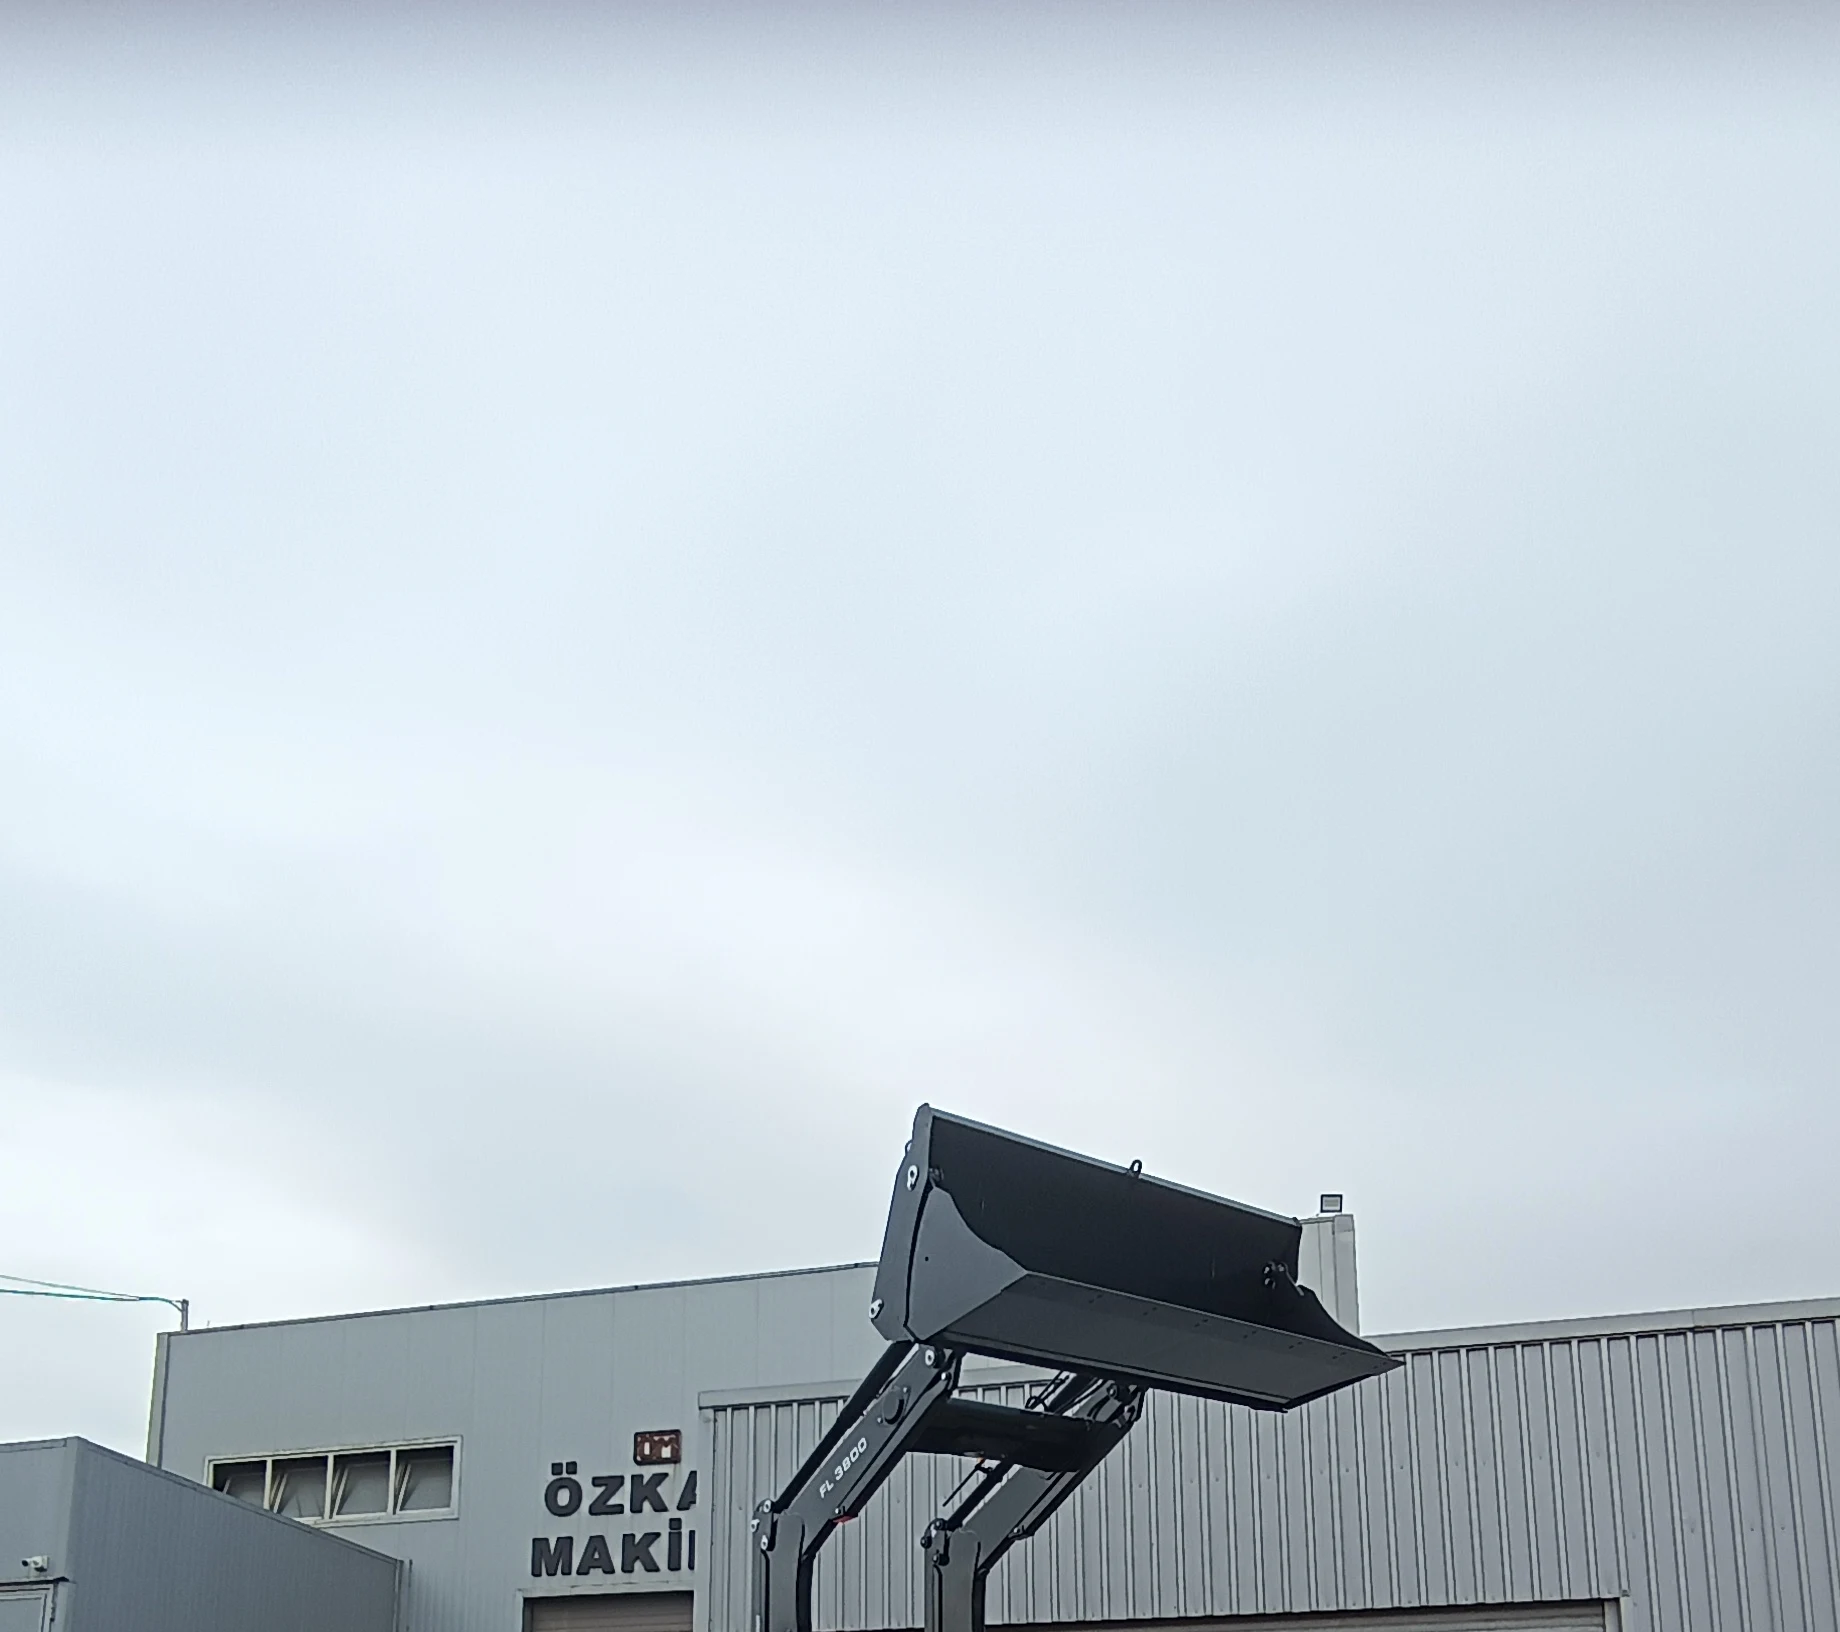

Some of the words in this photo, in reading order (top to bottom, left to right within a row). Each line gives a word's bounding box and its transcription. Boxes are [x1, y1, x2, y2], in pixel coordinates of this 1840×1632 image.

[819, 1480, 834, 1499] FL
[834, 1437, 867, 1481] 3800
[531, 1517, 695, 1577] MAKİ
